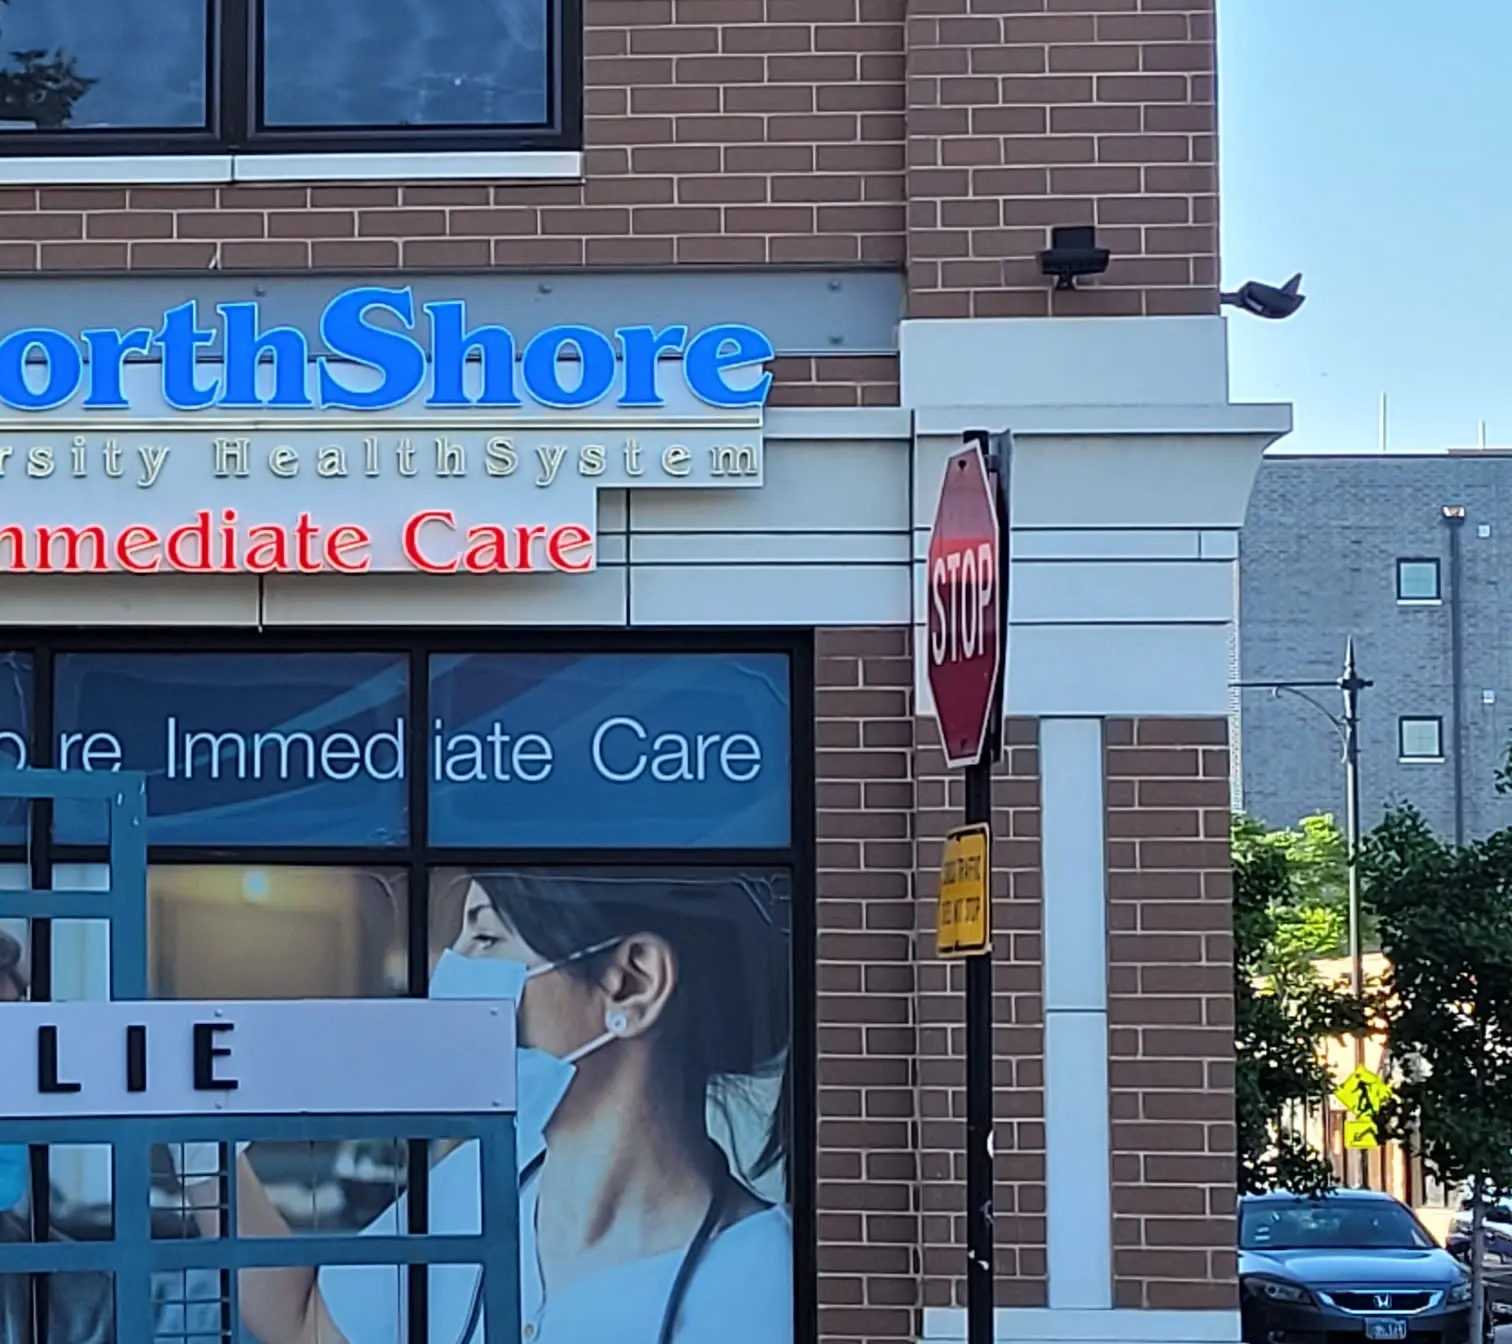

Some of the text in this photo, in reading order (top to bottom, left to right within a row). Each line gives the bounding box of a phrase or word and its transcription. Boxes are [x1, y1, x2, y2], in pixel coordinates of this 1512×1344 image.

[214, 433, 761, 486] HealthSystem
[402, 509, 595, 573] Care
[932, 543, 993, 666] STOP
[166, 715, 554, 783] Immediate
[591, 715, 764, 783] Care
